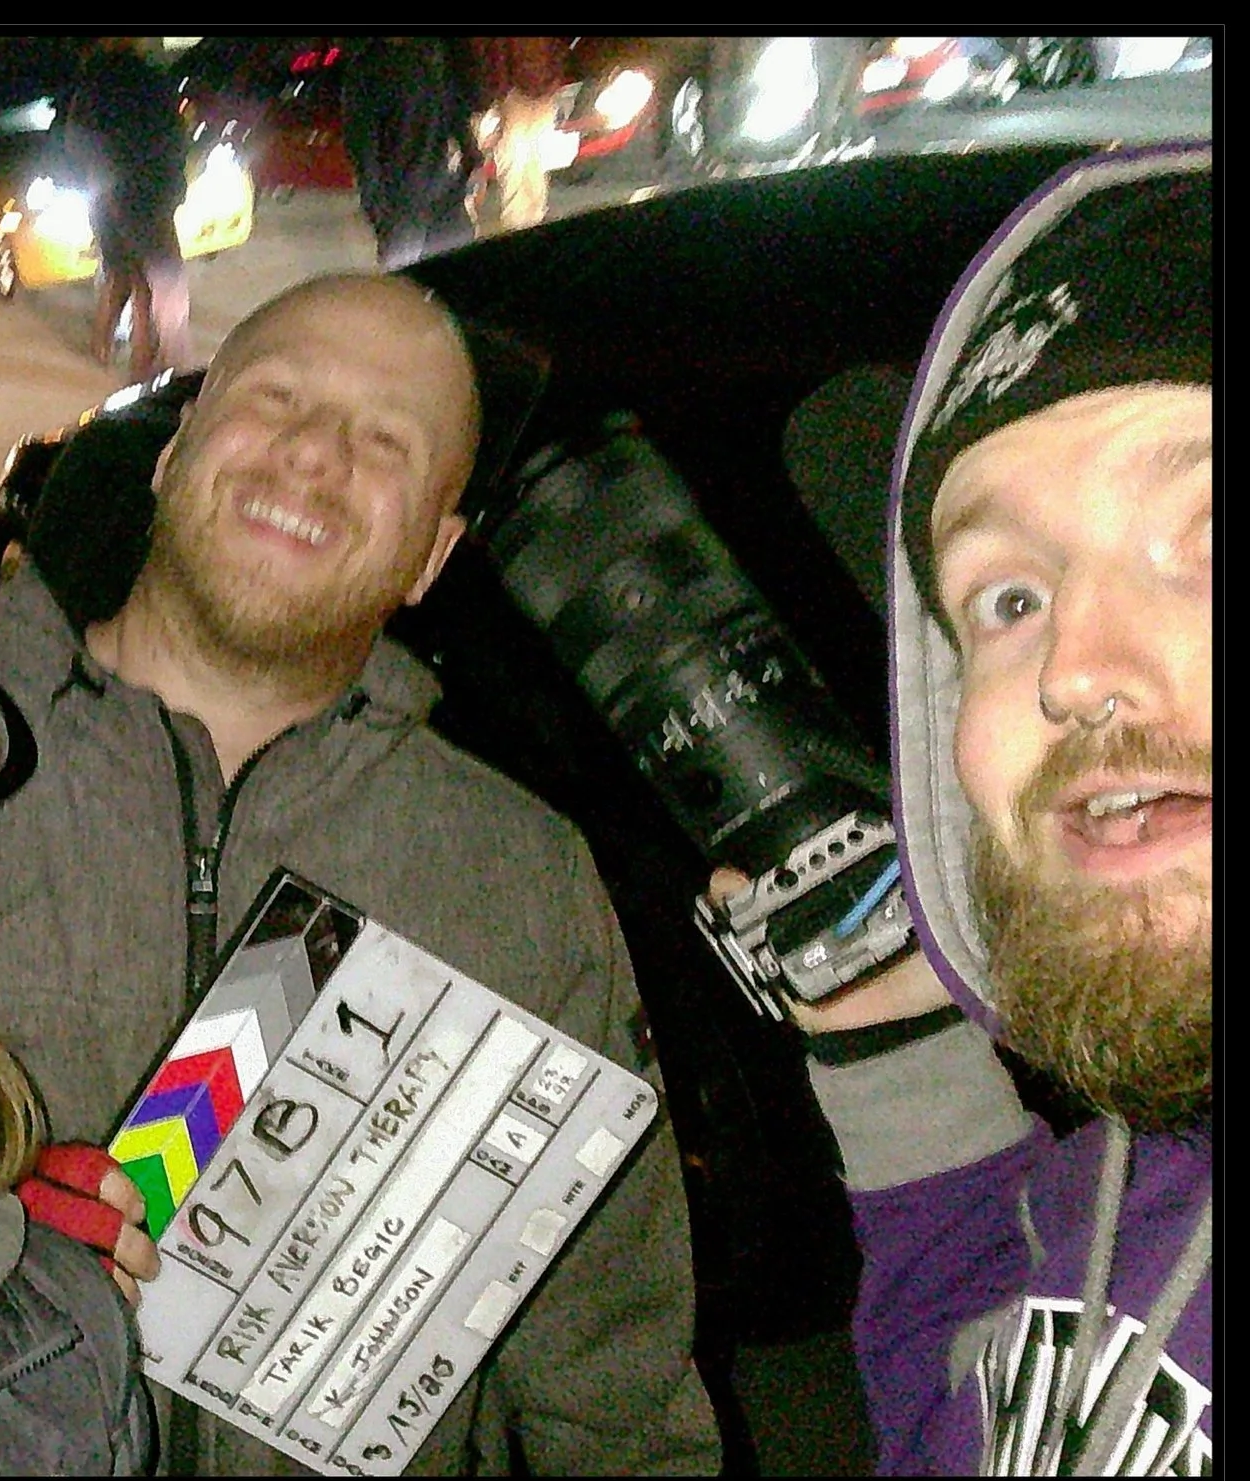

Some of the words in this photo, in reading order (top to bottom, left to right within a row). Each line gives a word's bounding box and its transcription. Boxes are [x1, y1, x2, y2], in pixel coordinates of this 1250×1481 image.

[335, 1000, 404, 1063] 1
[302, 1051, 349, 1083] TAKE
[516, 1091, 550, 1114] FPS
[622, 1092, 648, 1120] MOS
[506, 1130, 526, 1149] A
[476, 1151, 512, 1176] CAM
[562, 1179, 585, 1205] NITE
[216, 1303, 272, 1365] RISK
[349, 1050, 448, 1164] THERAPY
[507, 1261, 526, 1283] EXT
[258, 1315, 334, 1385] TARIK
[331, 1217, 404, 1297] BEGIC
[350, 1266, 434, 1374] JOHNSON
[286, 1429, 322, 1454] CAM
